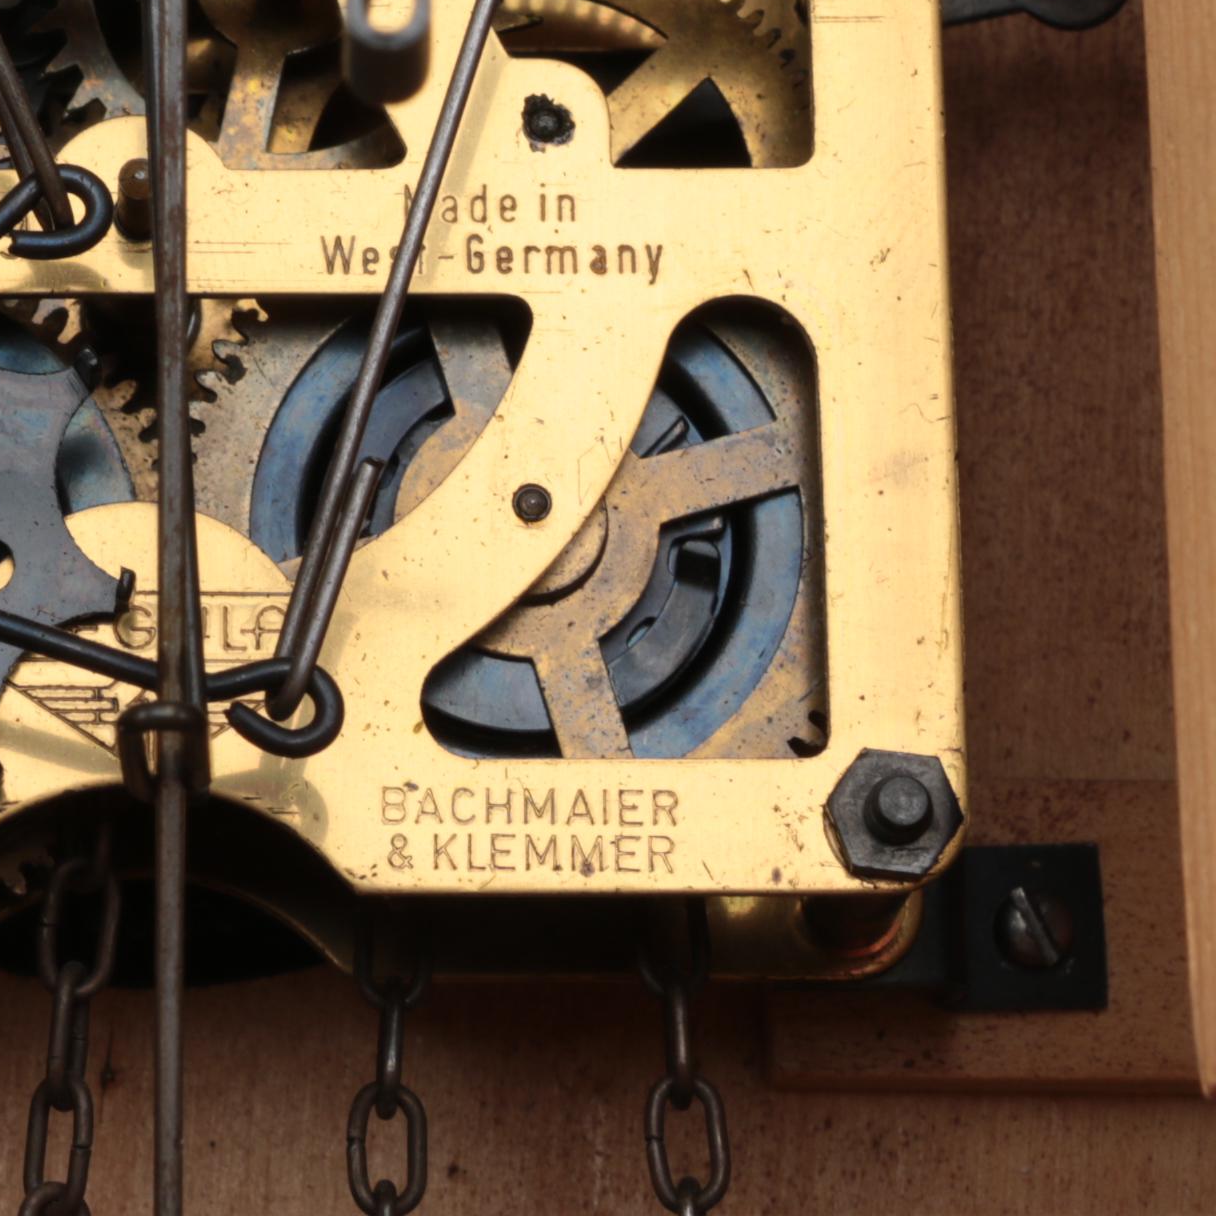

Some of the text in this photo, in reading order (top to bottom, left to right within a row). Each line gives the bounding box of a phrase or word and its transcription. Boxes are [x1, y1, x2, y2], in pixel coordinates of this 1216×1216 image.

[539, 183, 577, 222] in
[382, 786, 680, 826] BACHMAIER
[386, 832, 676, 874] & KLEMMER
